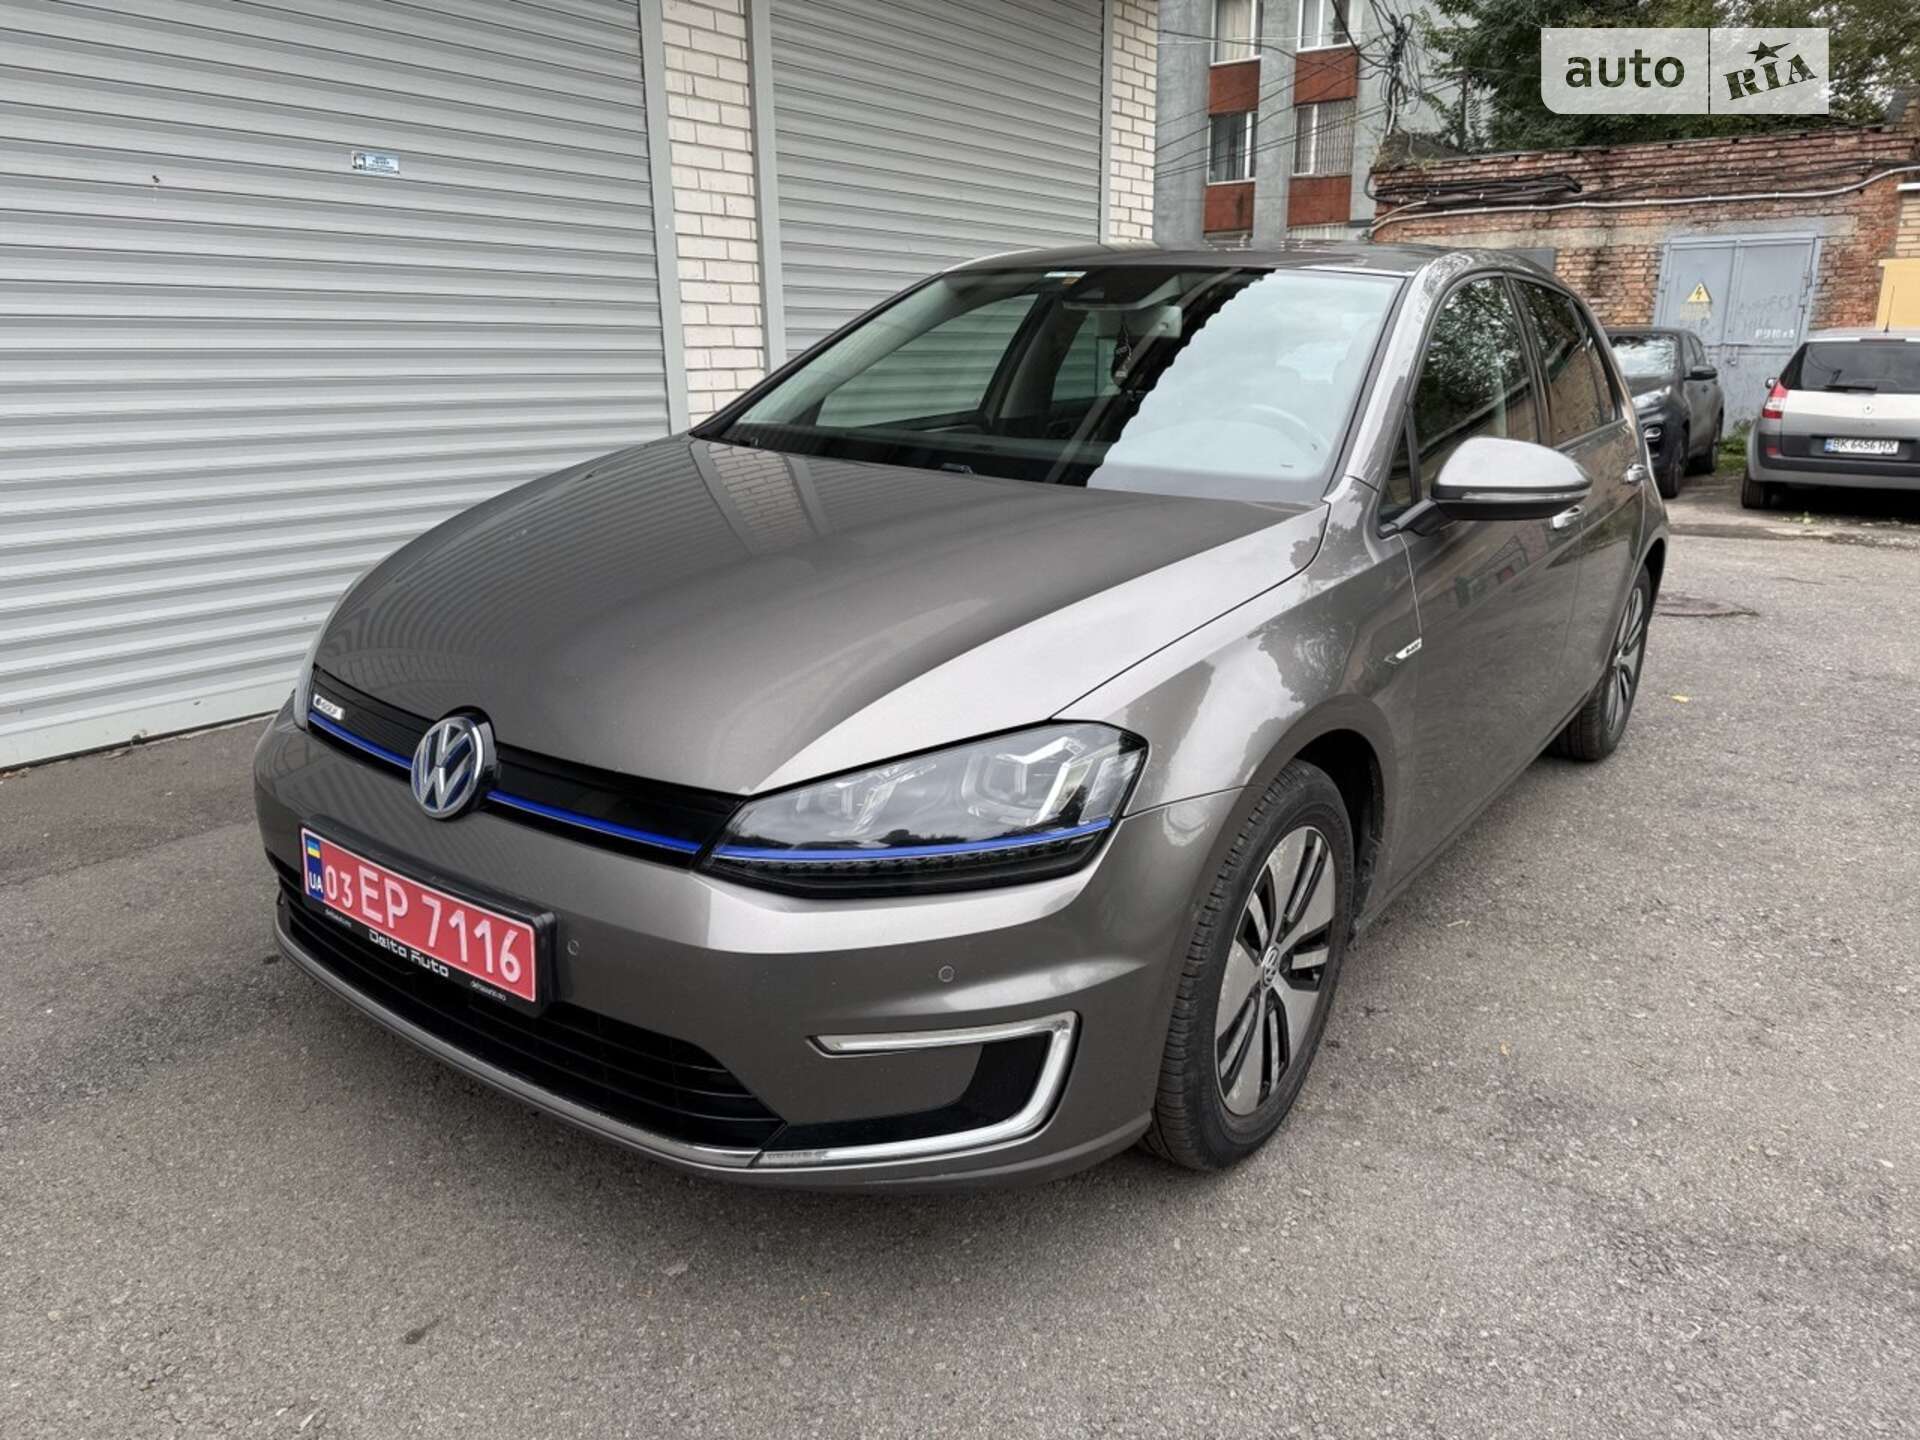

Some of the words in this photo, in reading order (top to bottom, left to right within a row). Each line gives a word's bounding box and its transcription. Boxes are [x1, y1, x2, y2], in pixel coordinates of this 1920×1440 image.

[309, 871, 323, 893] UA
[421, 893, 521, 984] 7116
[410, 949, 450, 978] Auto
